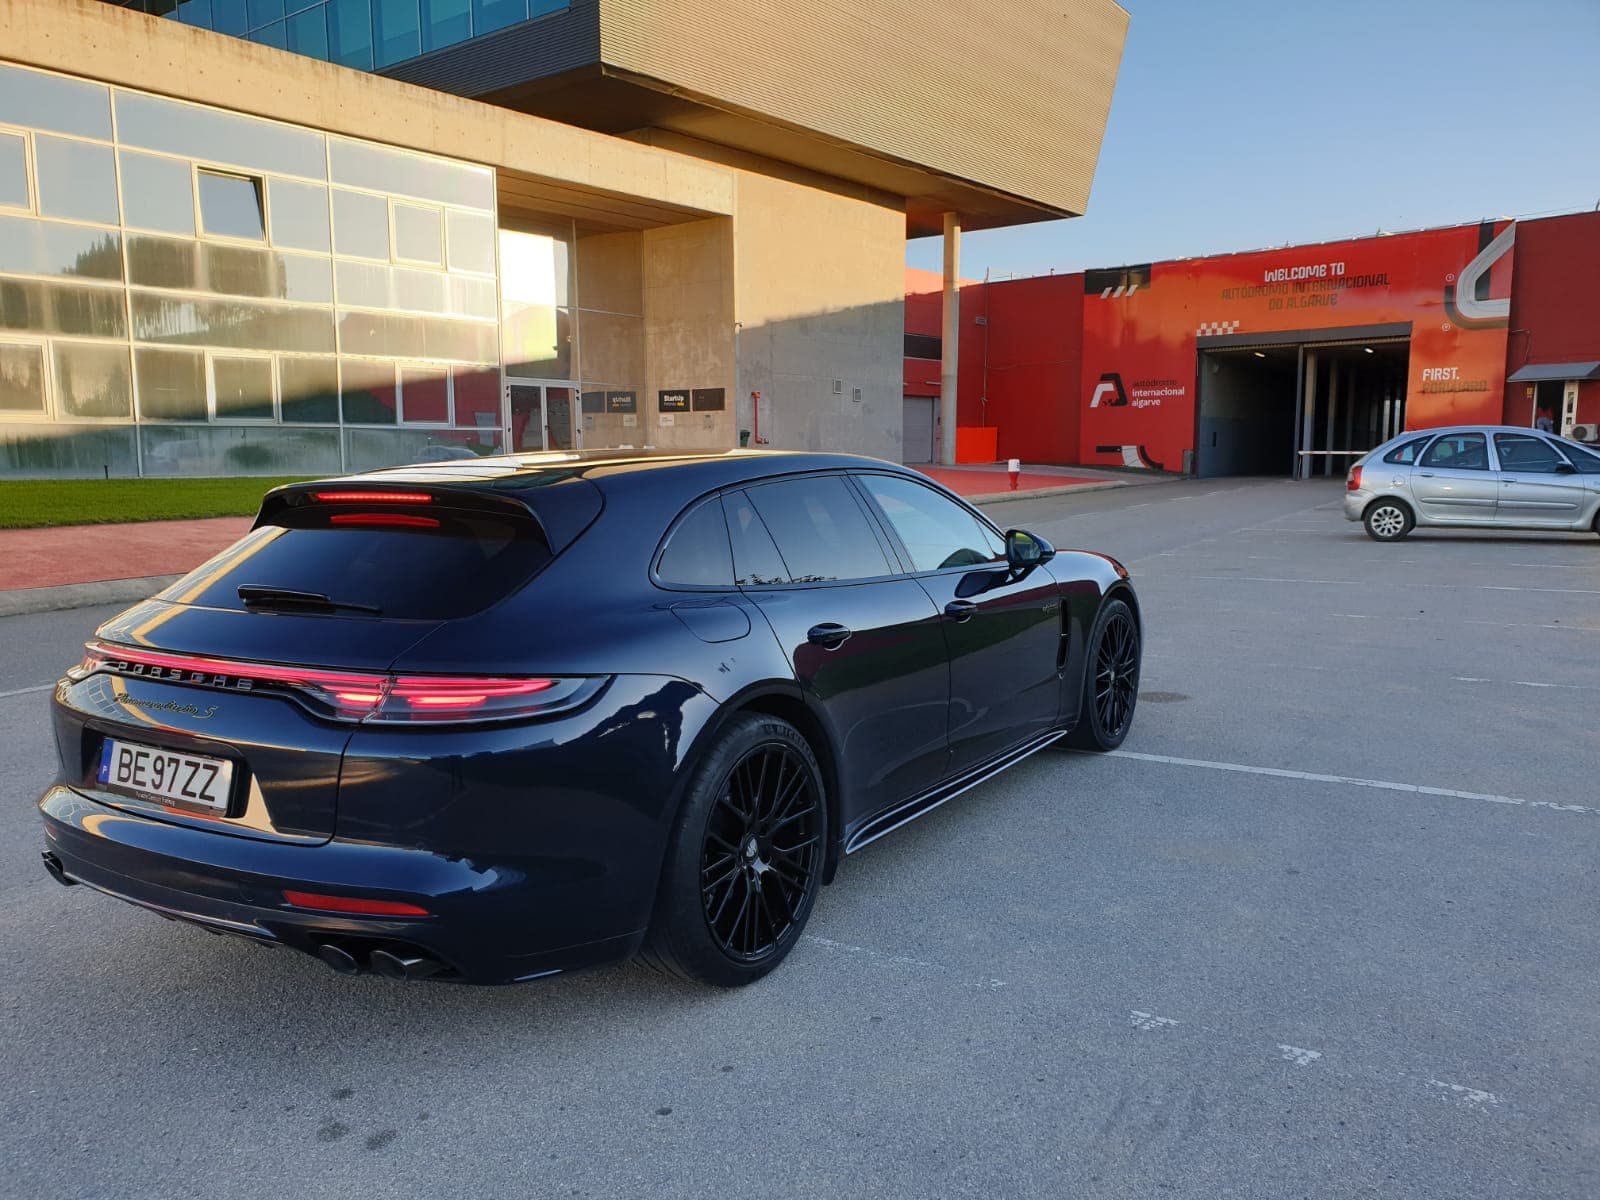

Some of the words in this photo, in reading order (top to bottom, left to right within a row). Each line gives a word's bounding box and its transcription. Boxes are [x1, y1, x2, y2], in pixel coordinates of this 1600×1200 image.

[1264, 264, 1327, 282] WELCOME
[1330, 262, 1345, 275] TO
[1292, 273, 1390, 293] INTERNACIONAL
[1268, 299, 1283, 311] DO
[1287, 293, 1338, 309] ALGARVE
[1422, 367, 1460, 381] FIRST.
[1132, 387, 1185, 397] internacional
[1131, 399, 1161, 409] algarve
[118, 661, 253, 690] PORSCHE
